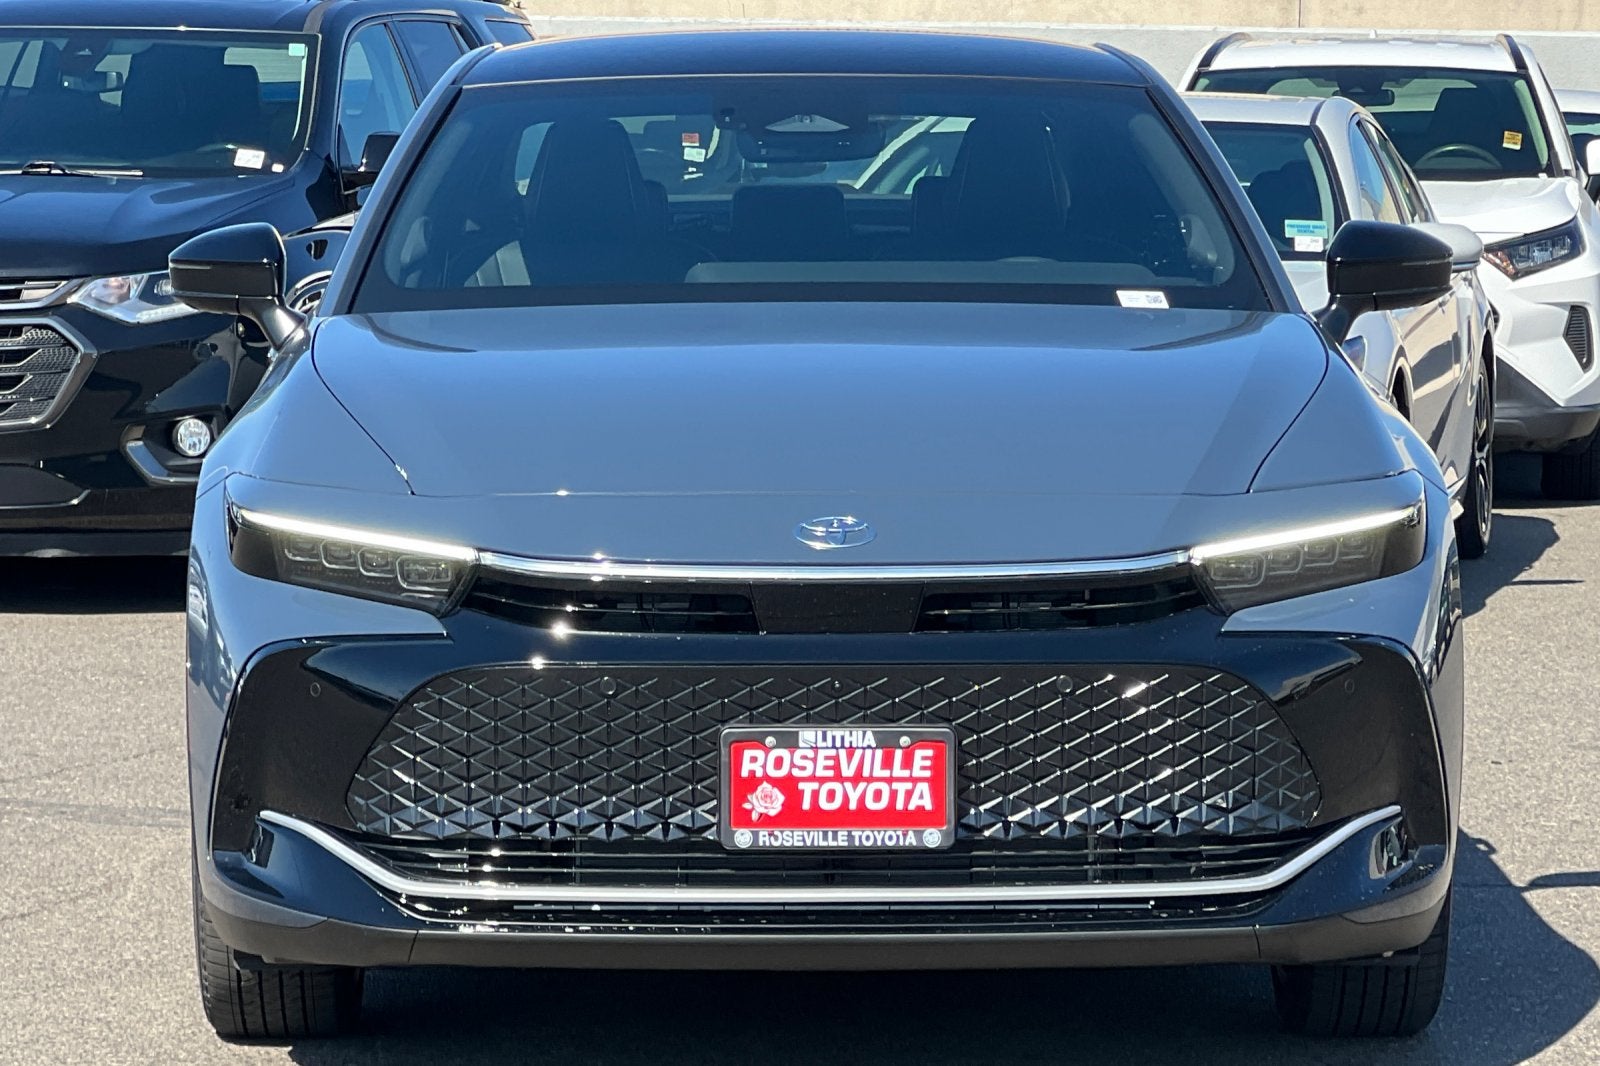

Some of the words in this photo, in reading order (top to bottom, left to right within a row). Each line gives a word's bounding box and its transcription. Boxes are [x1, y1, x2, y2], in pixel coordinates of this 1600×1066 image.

[816, 730, 876, 748] LITHIA
[740, 748, 934, 777] ROSEVILLE
[798, 782, 933, 811] TOYOTA
[758, 830, 848, 846] ROSEVILLE
[852, 830, 917, 846] TOYOTA
